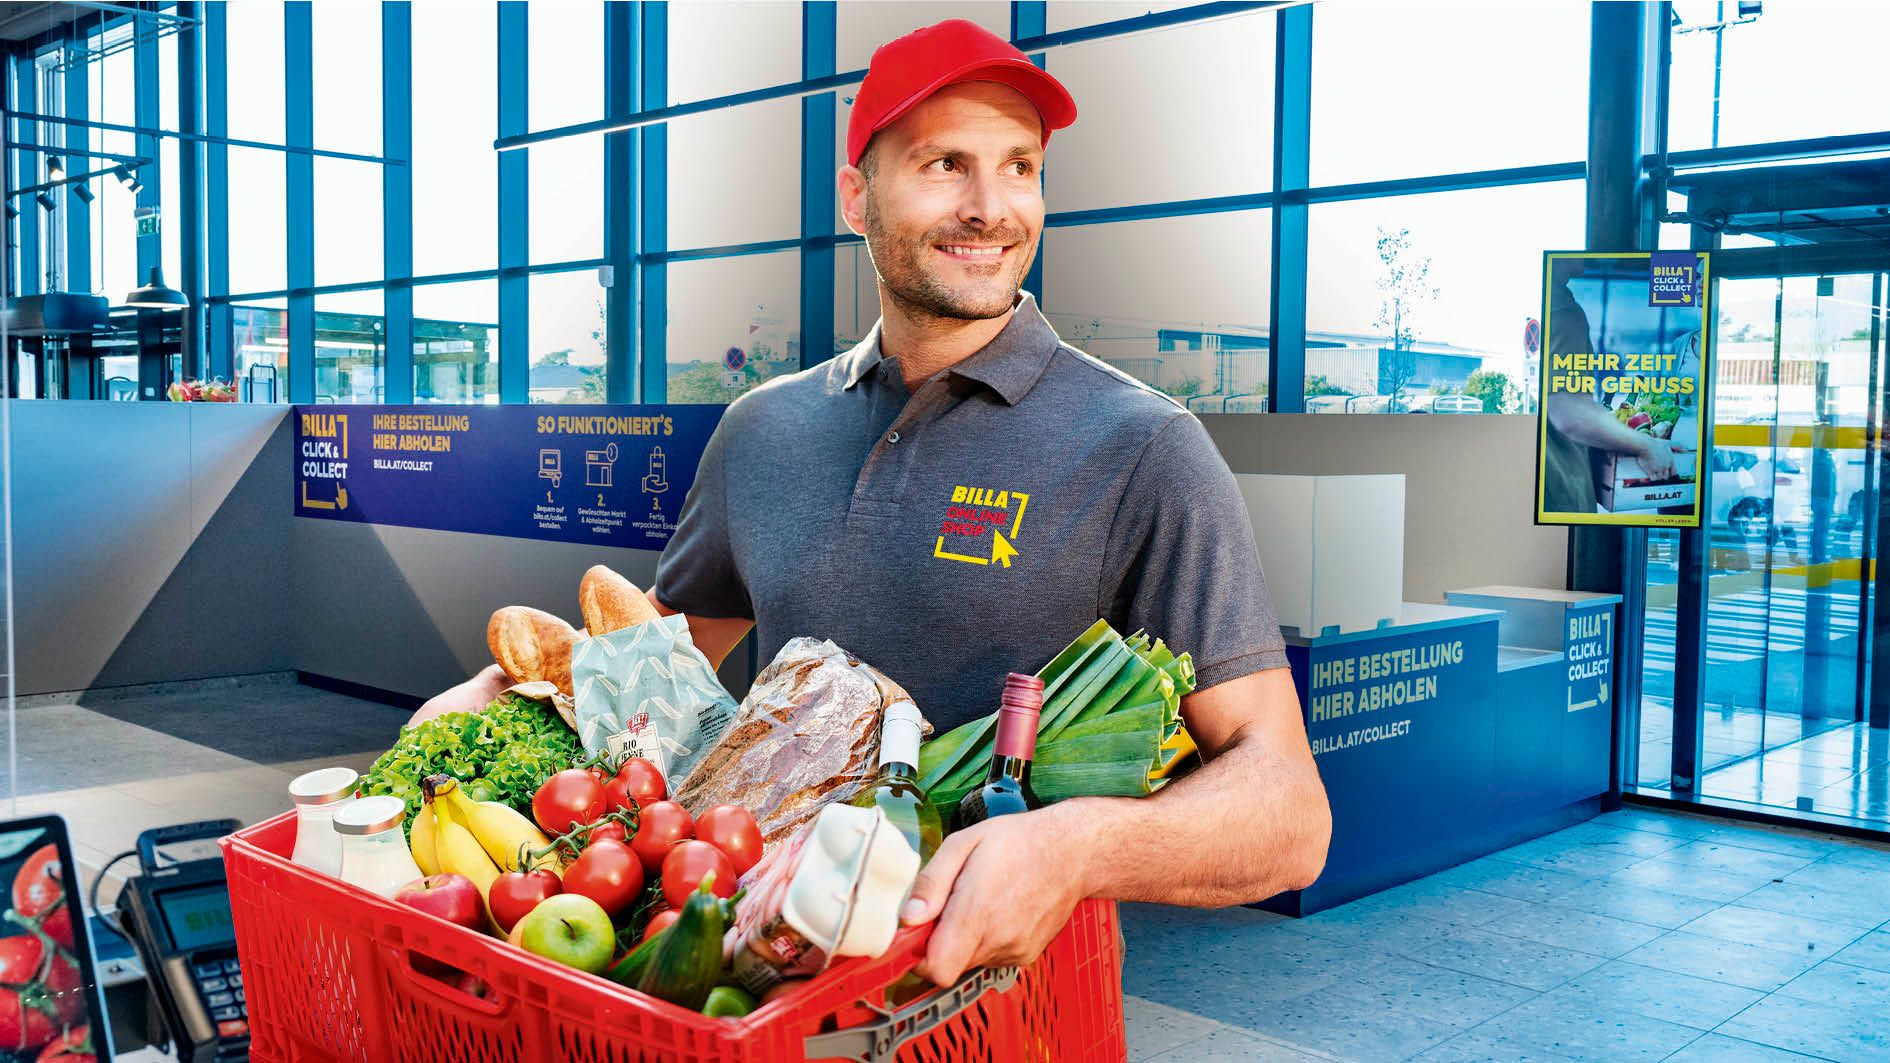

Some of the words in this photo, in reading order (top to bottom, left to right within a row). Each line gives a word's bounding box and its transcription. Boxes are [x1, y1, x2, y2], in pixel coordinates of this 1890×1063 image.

[1653, 266, 1684, 276] BILLA
[1653, 284, 1692, 292] COLLECT
[1552, 353, 1620, 371] MEHR
[1624, 354, 1677, 371] ZEIT
[1551, 371, 1596, 393] FÜR
[1601, 376, 1695, 394] GENUSS
[302, 414, 337, 437] BILLA
[372, 415, 397, 430] IHRE
[399, 415, 470, 432] BESTELLUNG
[537, 415, 556, 434] SO
[302, 441, 332, 458] CLICK
[333, 446, 339, 458] &
[372, 434, 397, 450] HIER
[398, 434, 451, 452] ABHOLEN
[302, 461, 348, 479] COLLECT
[373, 459, 433, 472] BILLA.AT/COLLECT
[546, 490, 554, 503] 1.
[597, 493, 606, 507] 2.
[652, 497, 662, 511] 3.
[951, 485, 1009, 509] BILLA
[649, 513, 665, 522] Fertig
[946, 505, 1009, 526] ONLINE
[632, 521, 662, 530] verpackten
[941, 520, 986, 537] SHOP
[1569, 614, 1602, 641] BILLA
[1569, 642, 1597, 662] CLICK
[1596, 644, 1603, 656] &
[1312, 658, 1356, 689] IHRE
[1358, 640, 1464, 682] BESTELLUNG
[1568, 658, 1611, 682] COLLECT
[1312, 688, 1355, 723] HIER
[1356, 675, 1438, 714] ABHOLEN
[1312, 719, 1412, 756] BILLA.AT/COLLECT
